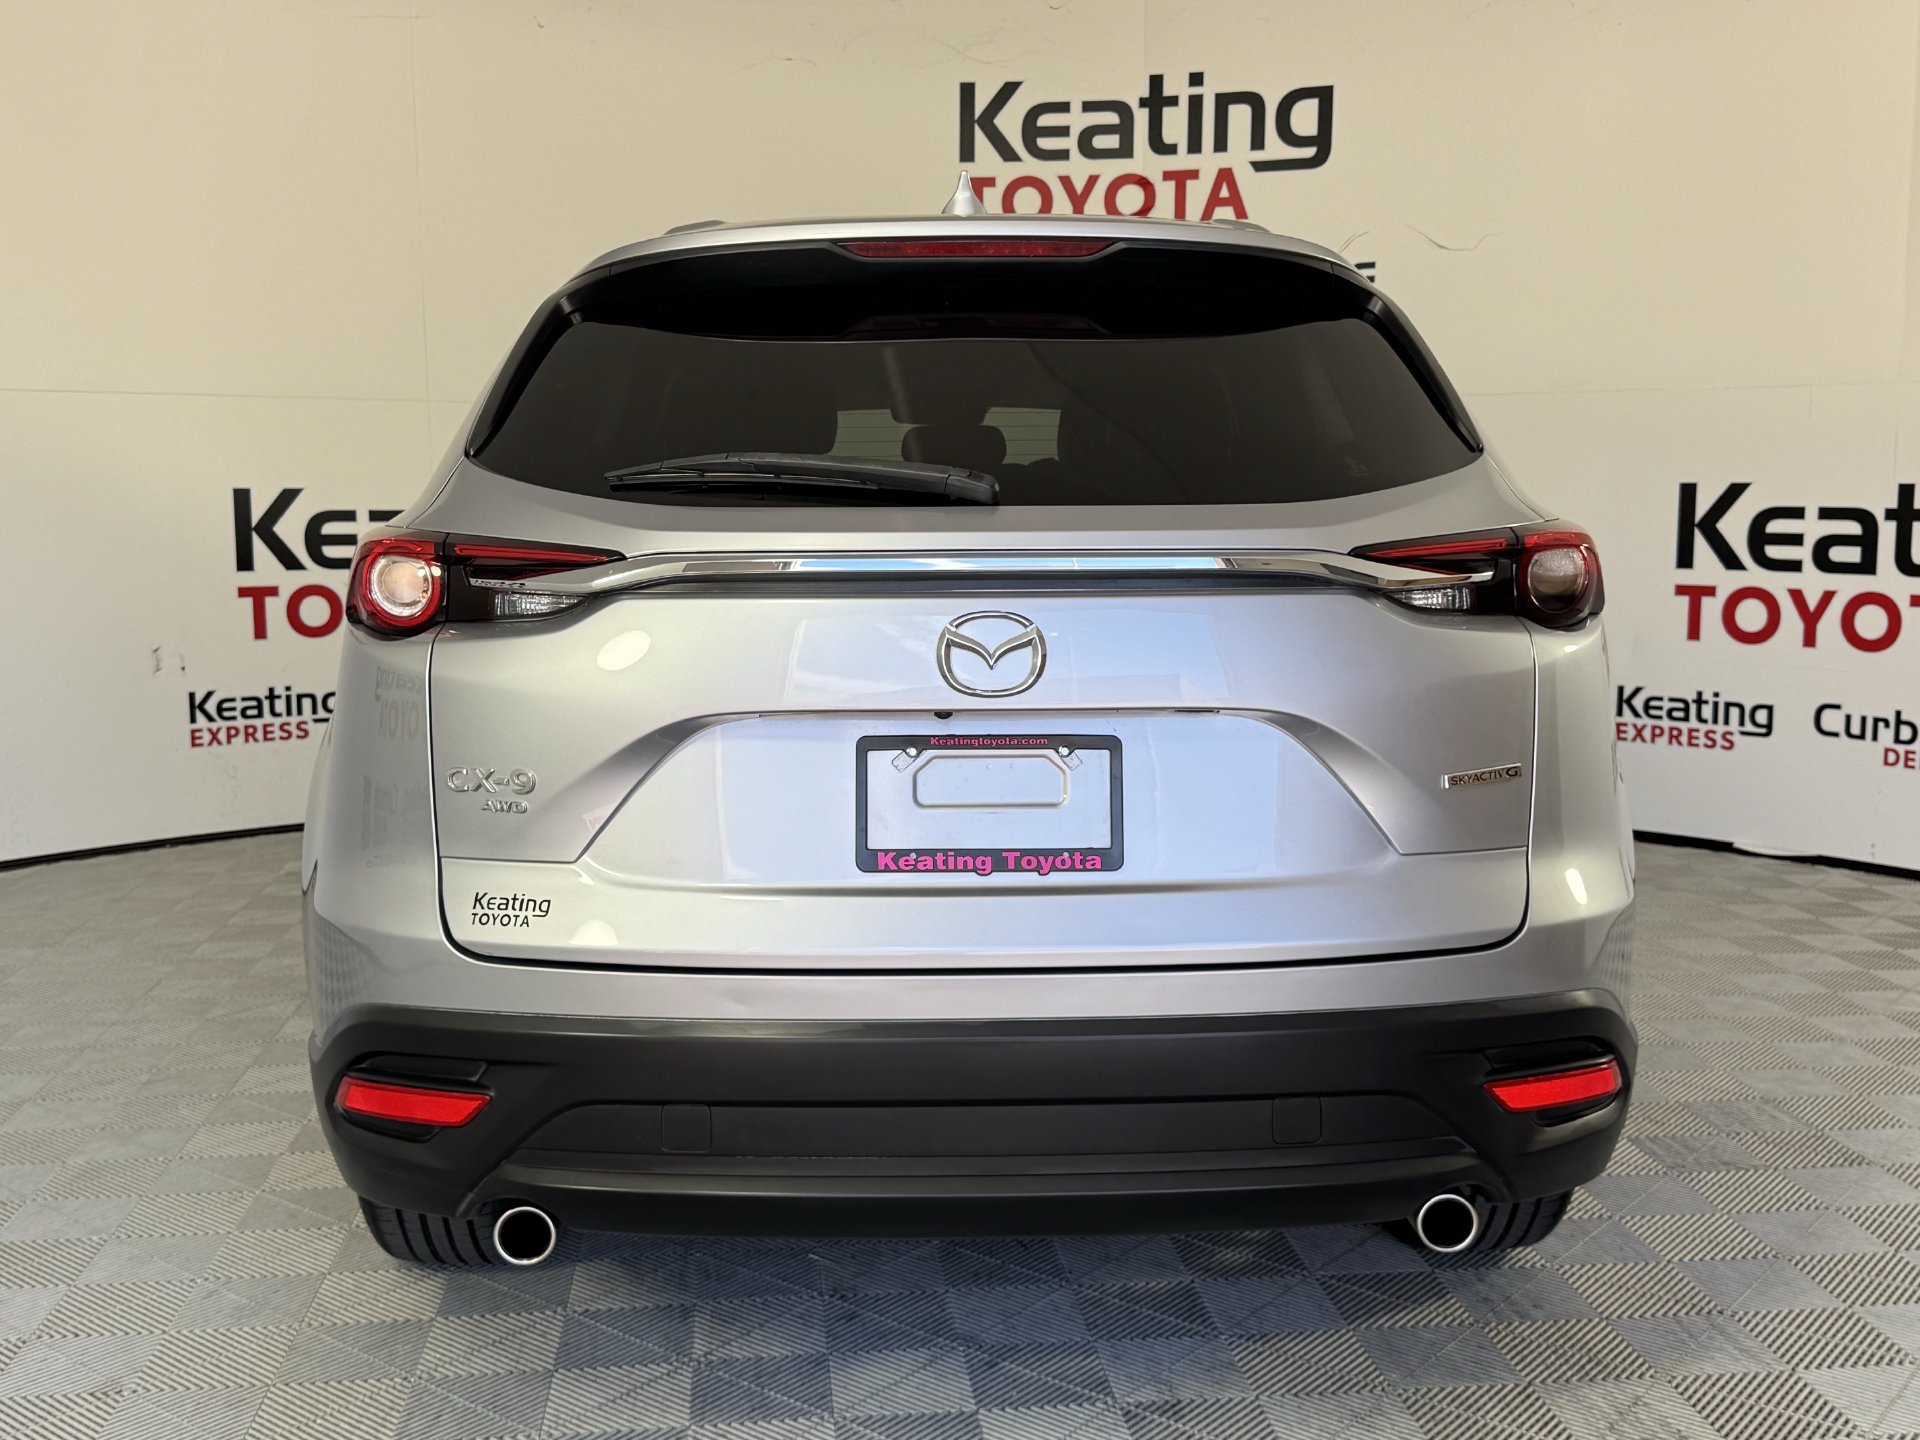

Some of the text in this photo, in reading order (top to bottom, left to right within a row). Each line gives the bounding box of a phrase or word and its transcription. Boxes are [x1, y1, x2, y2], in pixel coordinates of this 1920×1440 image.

[958, 71, 1334, 173] Keating
[237, 583, 344, 640] TO
[1615, 684, 1775, 738] Keating
[1813, 703, 1919, 746] Curb
[190, 720, 310, 749] EXPRESS
[929, 735, 1049, 747] Keatingtoyota.com
[1615, 721, 1736, 751] EXPRESS
[446, 766, 538, 796] CX-9
[480, 798, 529, 815] AWD
[876, 850, 1102, 875] Keating Toyota
[471, 891, 552, 918] Keating
[470, 912, 530, 928] TOYOTA
